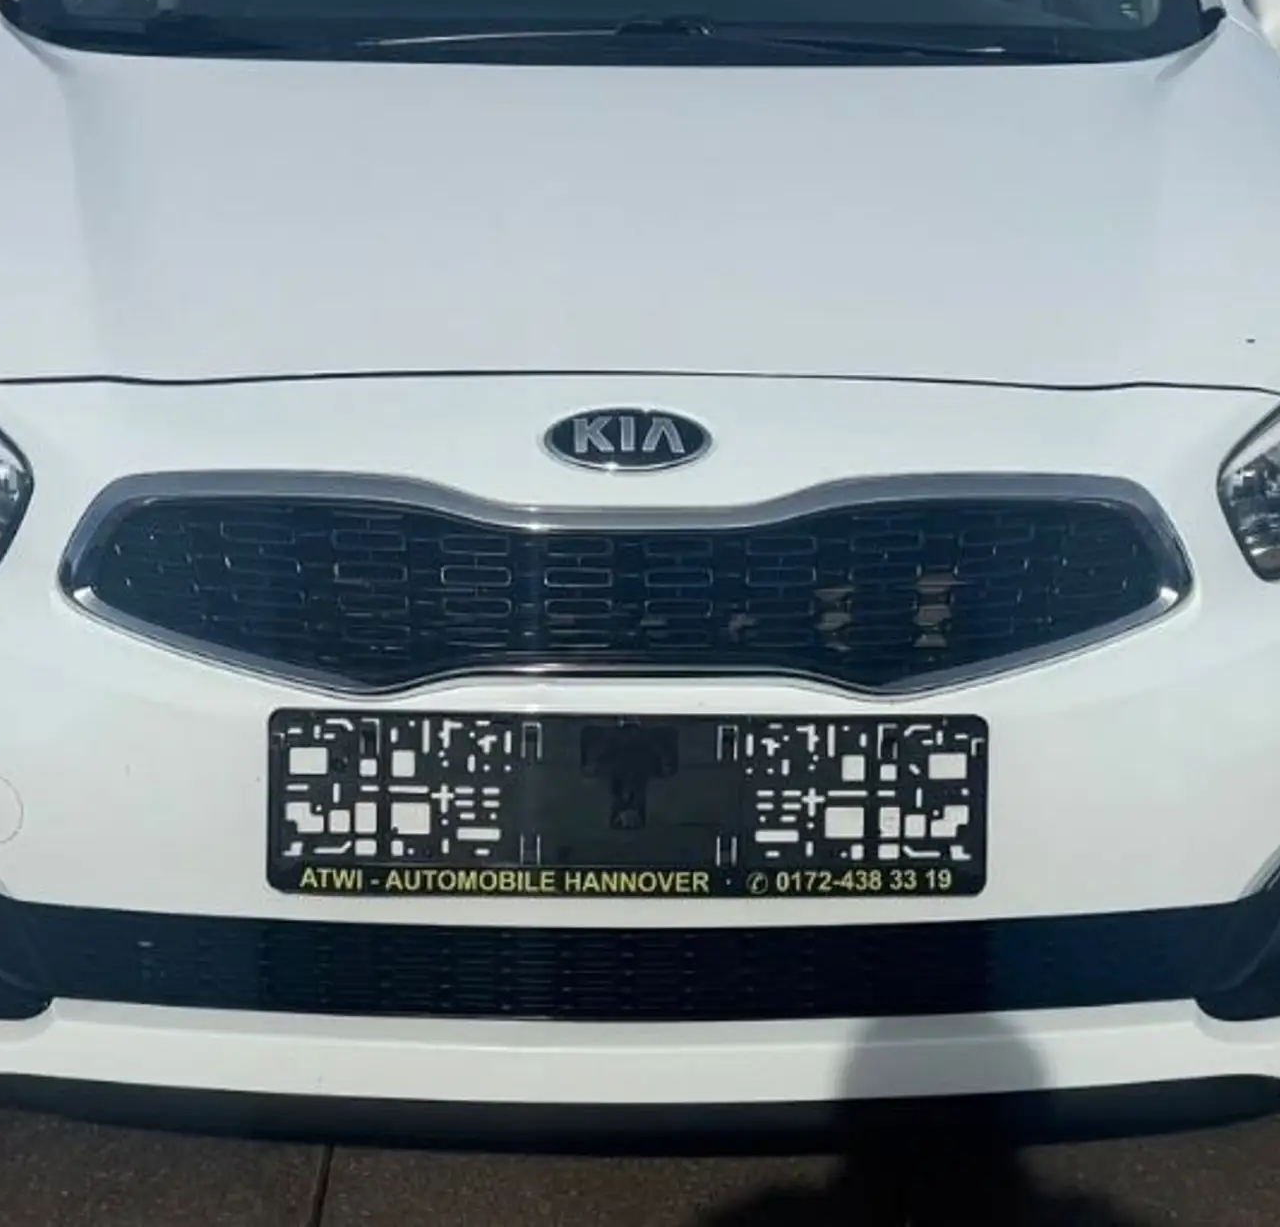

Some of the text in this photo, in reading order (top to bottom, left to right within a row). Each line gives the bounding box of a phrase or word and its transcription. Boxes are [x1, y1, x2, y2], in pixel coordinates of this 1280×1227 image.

[572, 415, 686, 454] KIA
[299, 867, 363, 889] ATWI
[385, 869, 556, 892] AUTOMOBILE
[564, 871, 710, 893] HANNOVER
[776, 870, 882, 891] 0172-438
[889, 869, 918, 890] 33
[925, 868, 952, 889] 19
